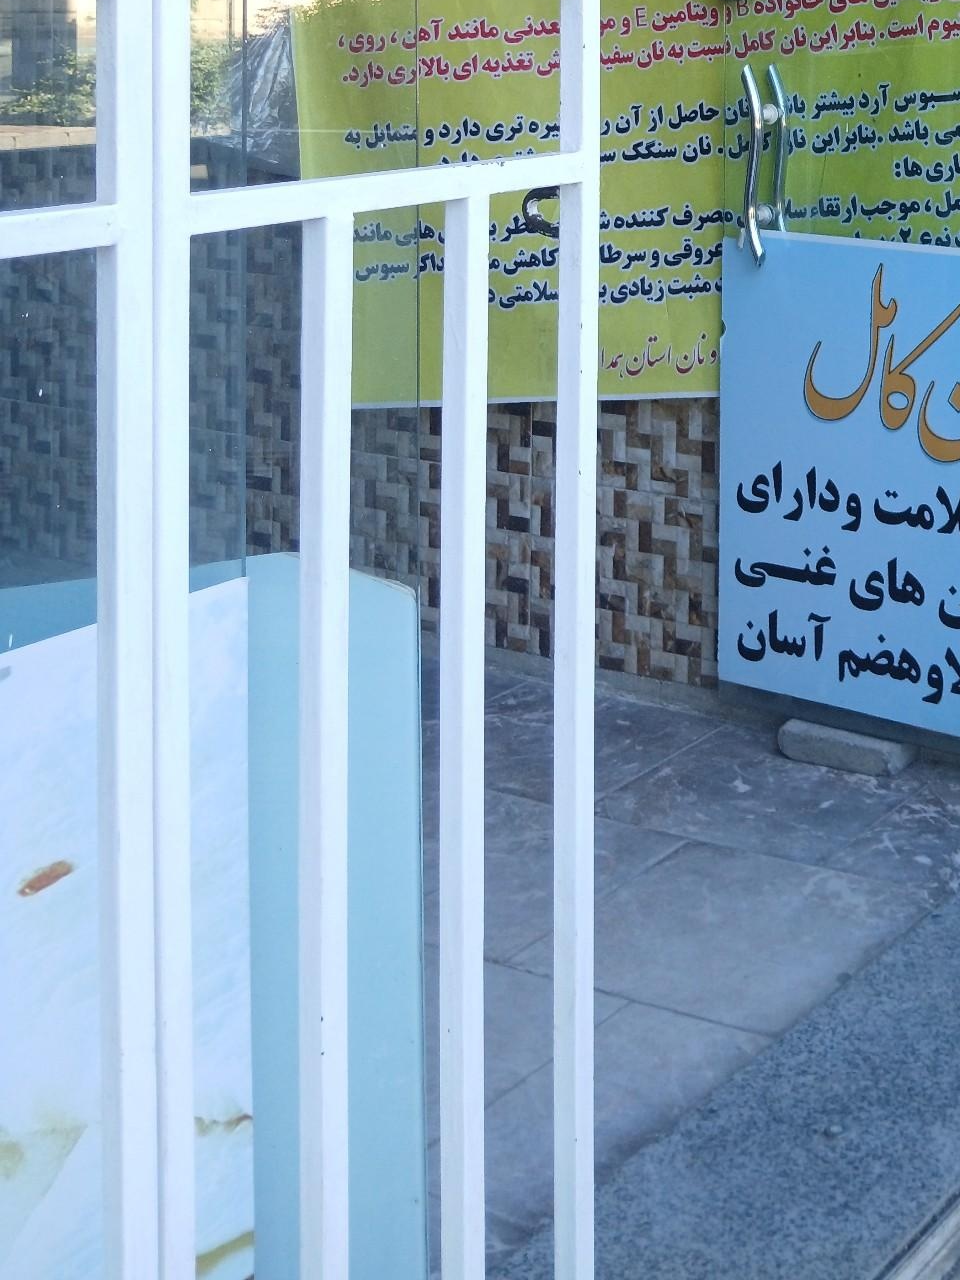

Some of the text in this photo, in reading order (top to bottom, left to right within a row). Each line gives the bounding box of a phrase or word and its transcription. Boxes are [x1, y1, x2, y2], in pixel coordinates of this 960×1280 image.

[447, 18, 500, 41] مانند
[619, 16, 632, 36] و
[635, 7, 648, 28] E
[651, 0, 720, 32] ویتامین
[637, 40, 665, 69] نان
[667, 42, 684, 64] به
[734, 30, 776, 60] کامل
[780, 26, 807, 56] نان
[451, 54, 479, 82] ای
[481, 51, 534, 78] تغذیه
[810, 91, 856, 120] بیشتر
[857, 84, 891, 115] آرد
[485, 115, 525, 144] تری
[615, 104, 642, 135] آن
[647, 106, 664, 133] از
[667, 102, 720, 130] حاصل
[344, 128, 362, 151] به
[422, 125, 435, 147] و
[437, 117, 482, 145] دارد
[888, 119, 930, 147] باشد
[621, 139, 678, 162] سنگک
[682, 135, 713, 164] نان
[612, 207, 670, 230] کننده
[672, 203, 735, 232] مصرف
[809, 195, 859, 225] ارتقاء
[859, 197, 922, 222] موجب
[600, 243, 648, 270] سرطا
[650, 250, 660, 268] و
[355, 262, 411, 282] سبوس
[610, 275, 665, 304] زیادی
[667, 274, 712, 301] مثبت
[625, 332, 718, 377] و نان استان
[734, 544, 837, 587] غنی
[849, 556, 926, 612] های
[736, 610, 832, 663] آسان
